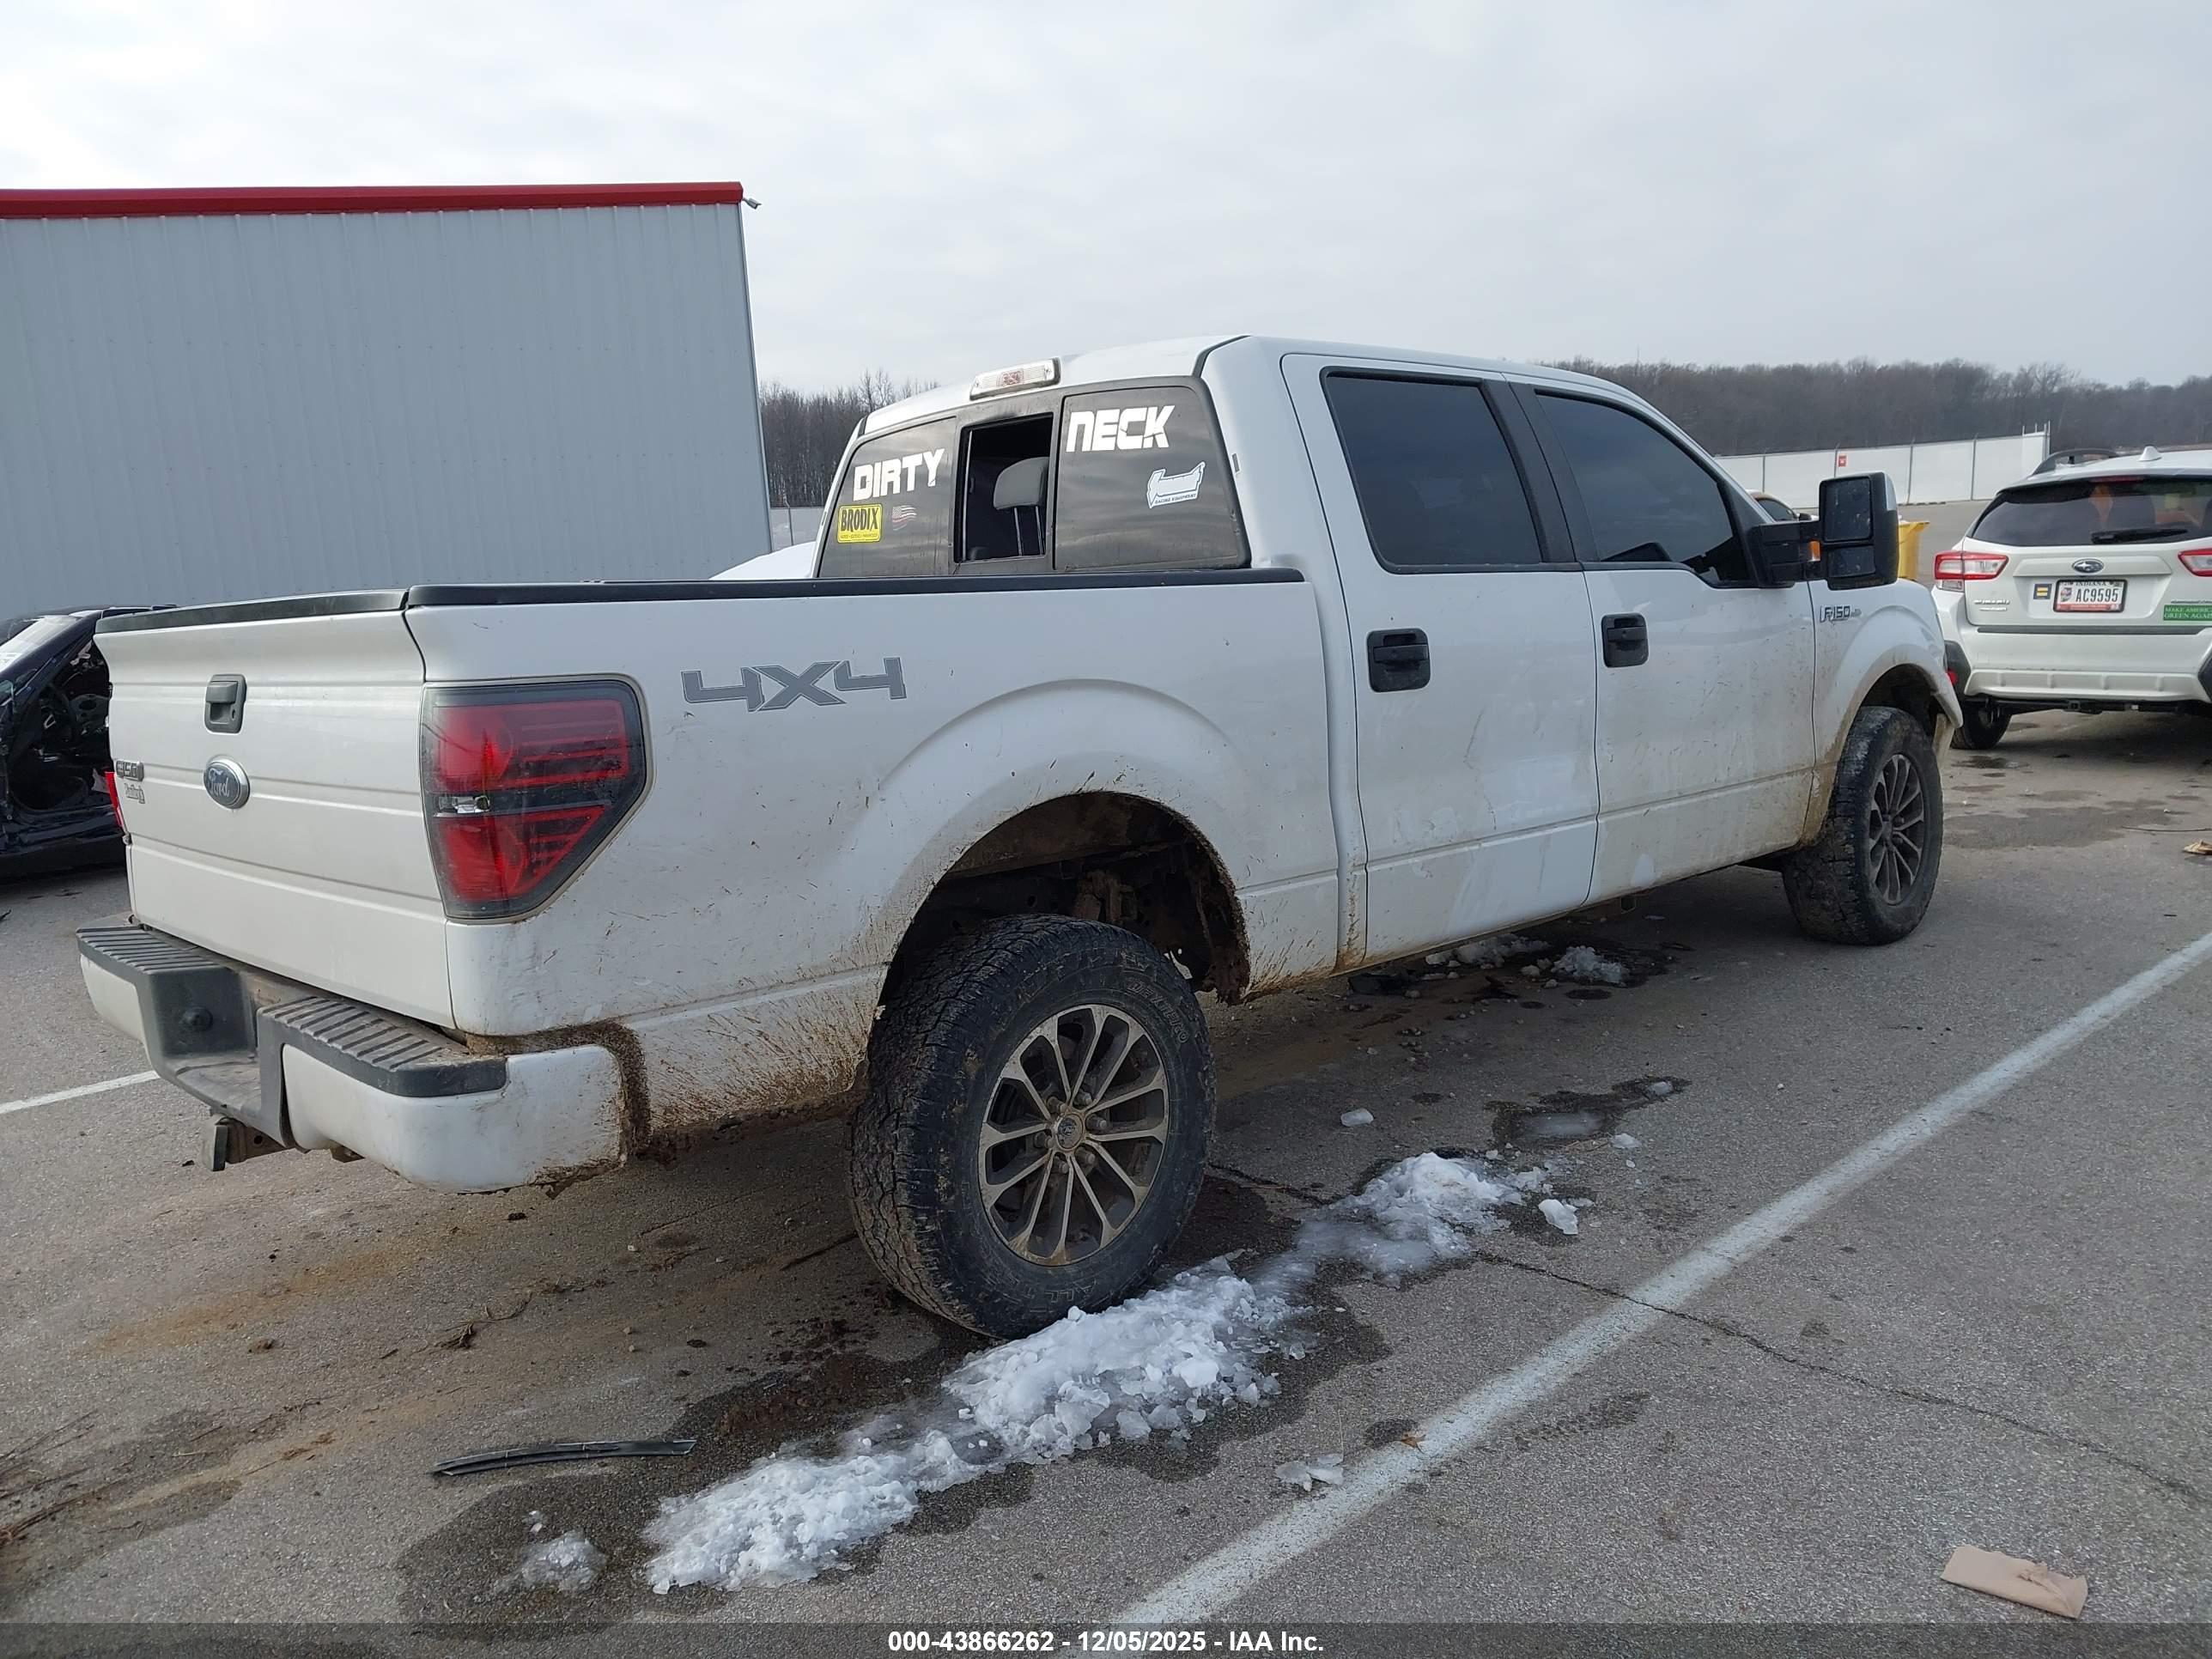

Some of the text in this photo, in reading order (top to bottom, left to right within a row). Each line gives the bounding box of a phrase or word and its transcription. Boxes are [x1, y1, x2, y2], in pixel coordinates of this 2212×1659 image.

[1066, 404, 1176, 453] NECK
[853, 448, 946, 501] DIRTY
[841, 507, 878, 532] BRODIX
[2075, 587, 2119, 603] AC9595
[208, 768, 230, 797] Ford
